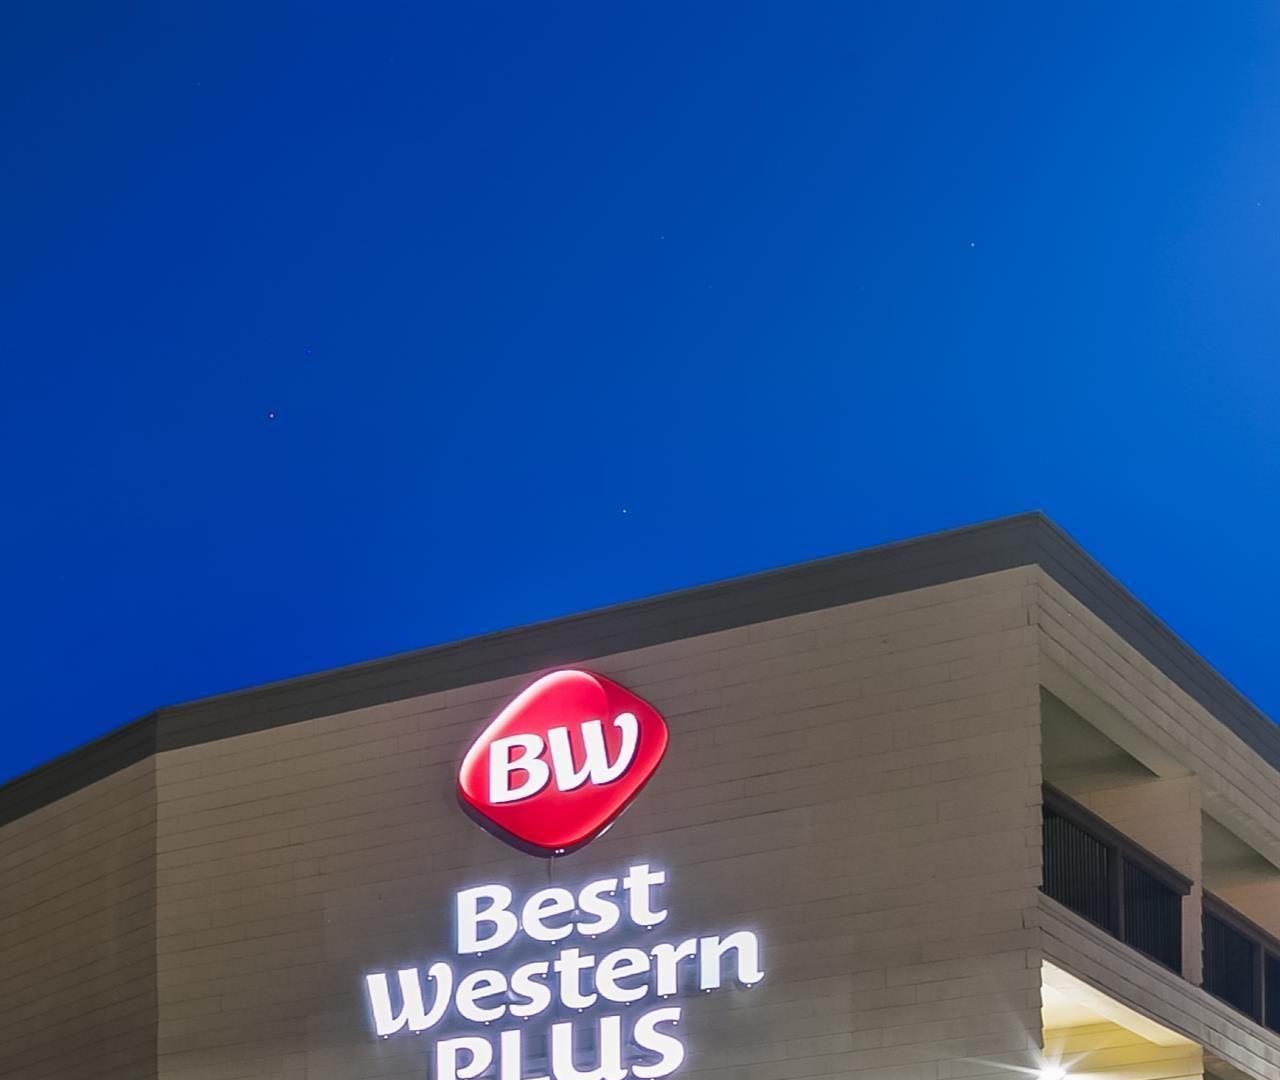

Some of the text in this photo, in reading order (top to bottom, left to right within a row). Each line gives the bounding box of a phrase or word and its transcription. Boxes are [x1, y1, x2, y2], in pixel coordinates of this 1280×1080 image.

[488, 712, 639, 804] BW
[456, 863, 668, 955] Best
[366, 930, 765, 1037] Western
